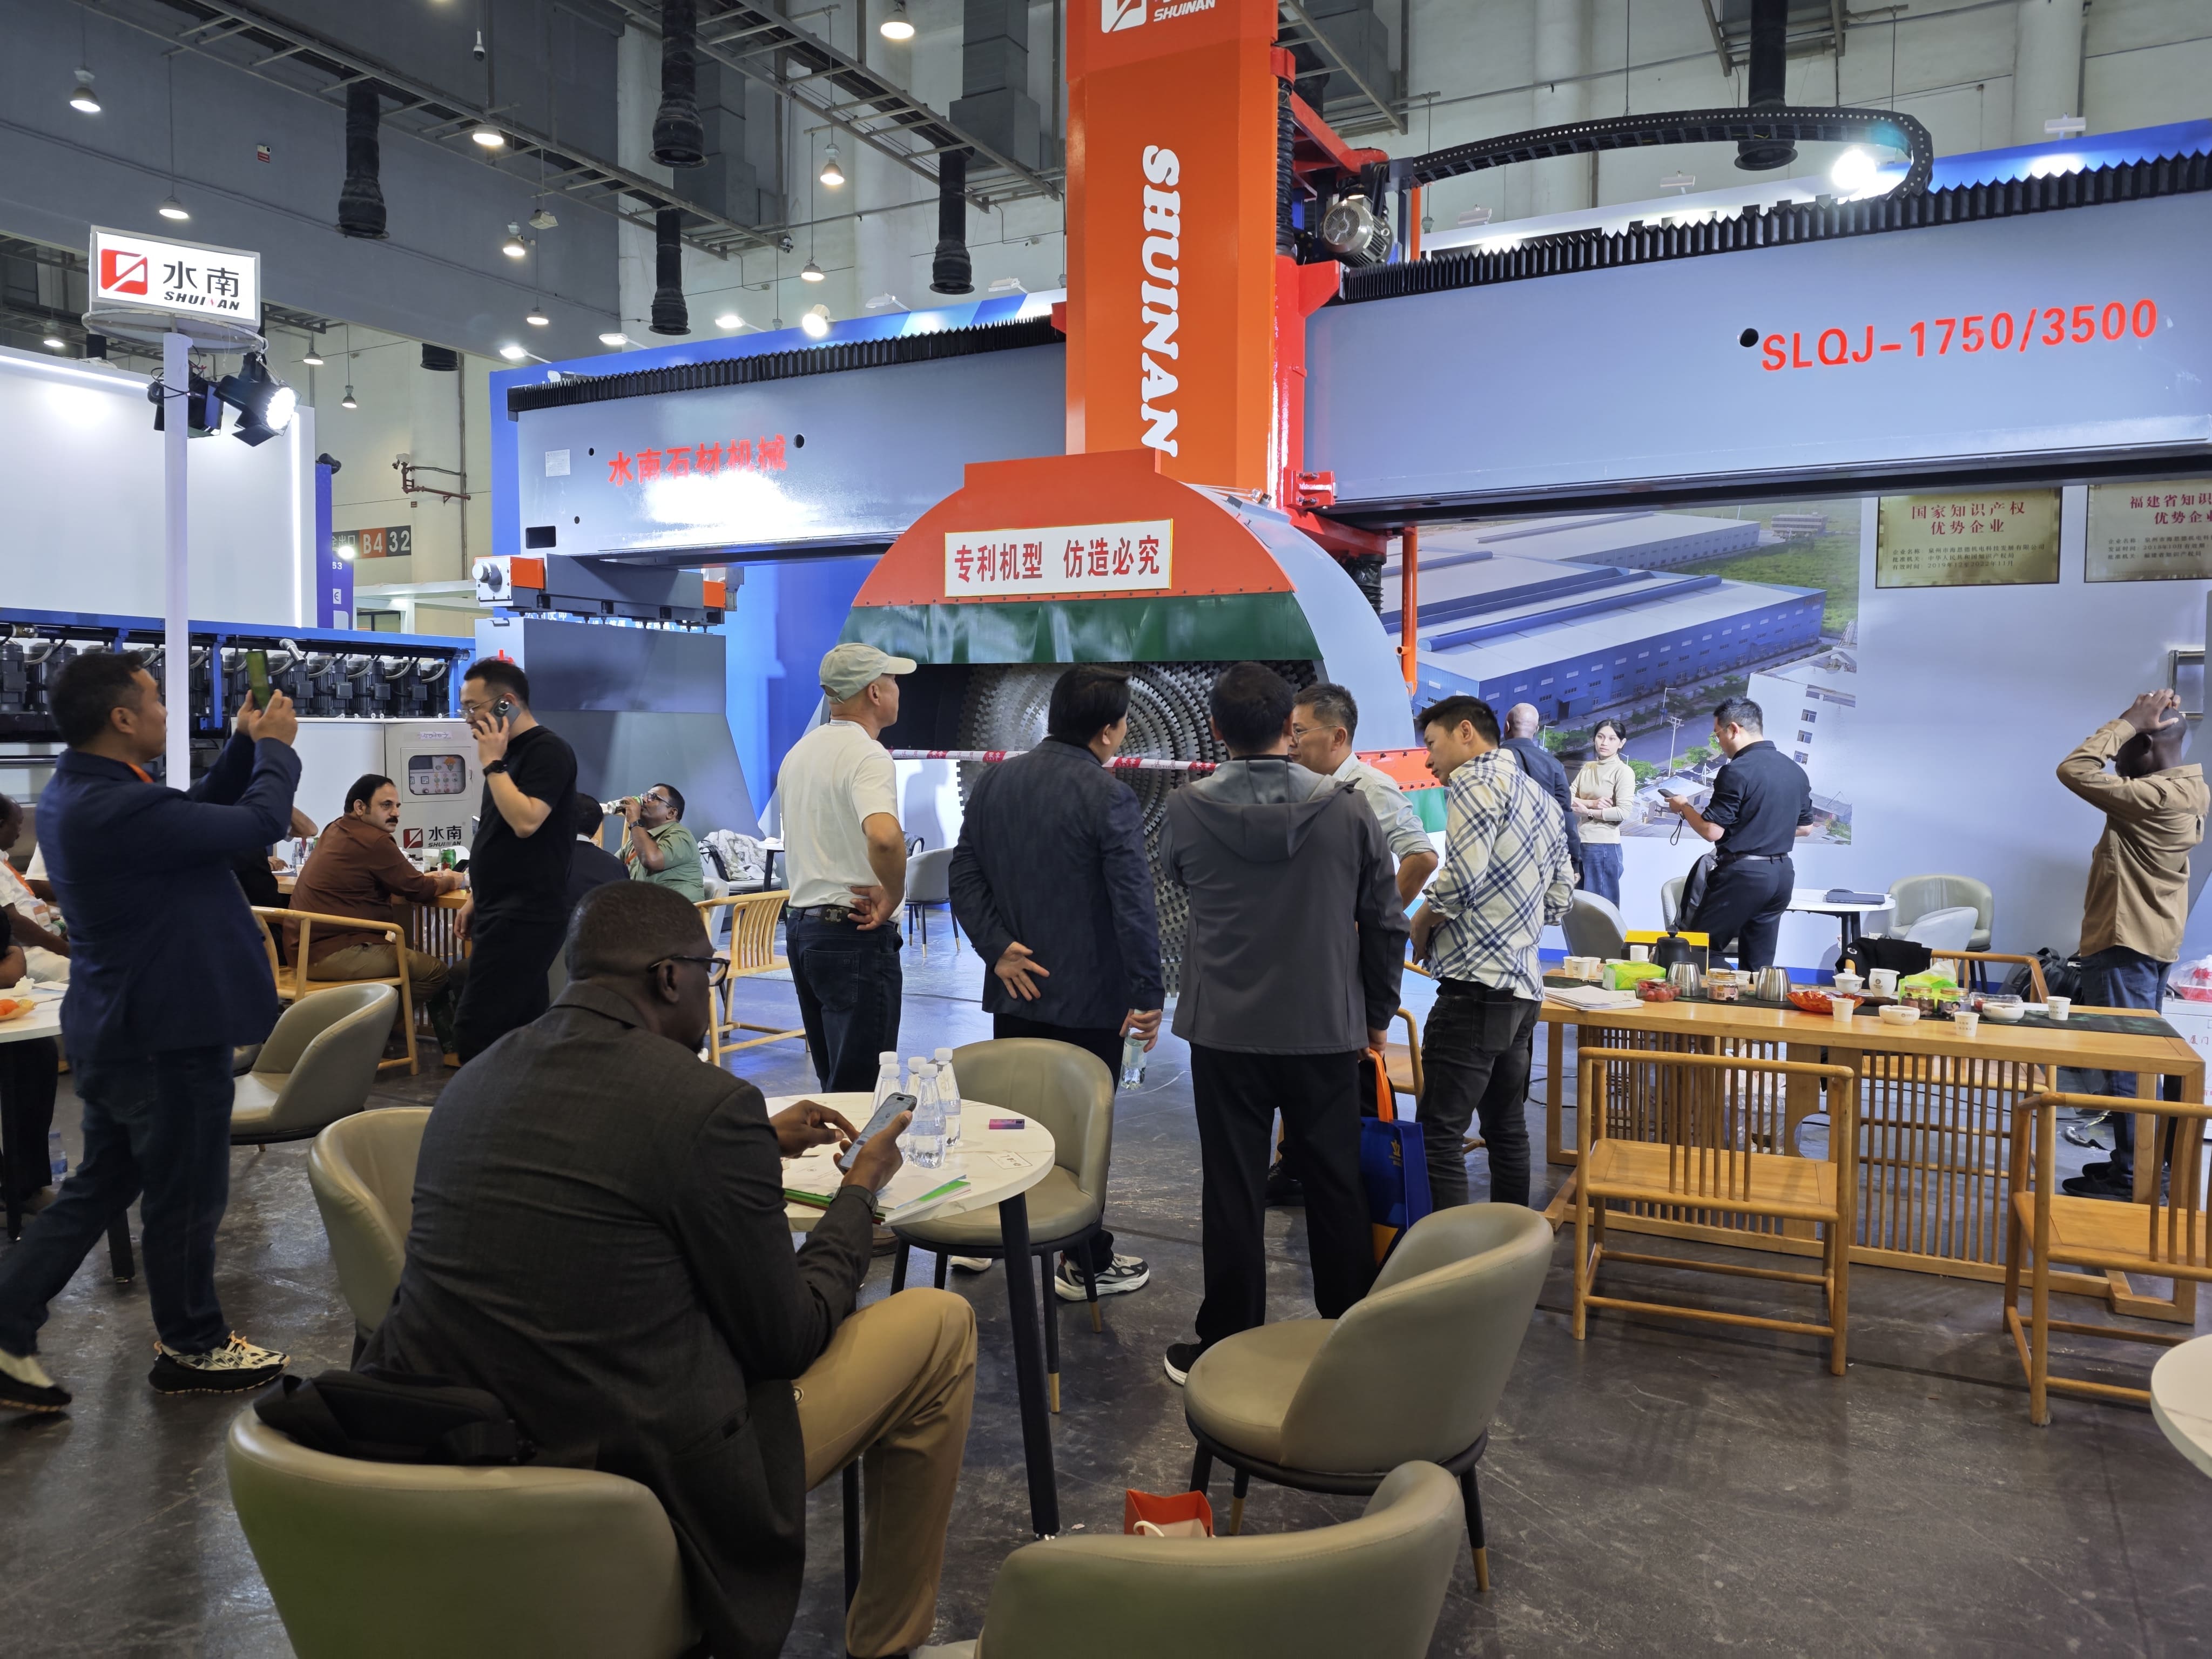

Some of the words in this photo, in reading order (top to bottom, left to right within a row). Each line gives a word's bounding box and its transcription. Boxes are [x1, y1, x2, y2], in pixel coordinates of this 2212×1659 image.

[1154, 0, 1215, 22] SHUINAN
[163, 261, 239, 298] 水南
[1141, 145, 1181, 457] SHUINAN
[1762, 298, 2159, 372] SLQJ-1750/3500
[608, 434, 787, 487] 水南石材机械
[1912, 501, 2025, 520] 国家知识产权
[1931, 518, 2004, 535] 优势企业
[363, 532, 383, 554] B4
[389, 530, 410, 552] 32
[954, 541, 1042, 583] 专利机型
[1063, 535, 1159, 578] 仿造必究
[428, 825, 462, 841] 水南
